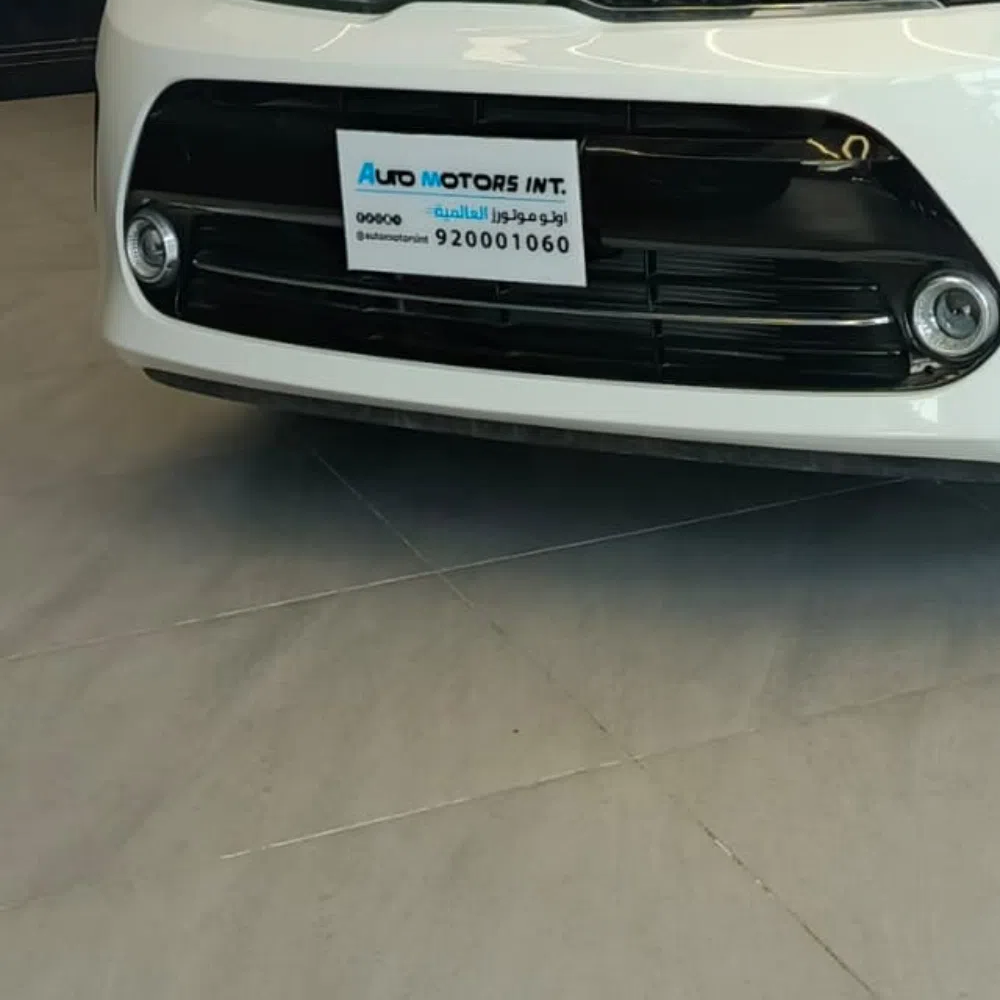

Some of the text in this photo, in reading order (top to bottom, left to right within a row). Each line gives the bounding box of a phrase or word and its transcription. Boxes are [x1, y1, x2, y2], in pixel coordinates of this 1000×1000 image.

[525, 177, 567, 195] INT.
[432, 203, 489, 221] العالمية
[435, 228, 570, 254] 920001060
